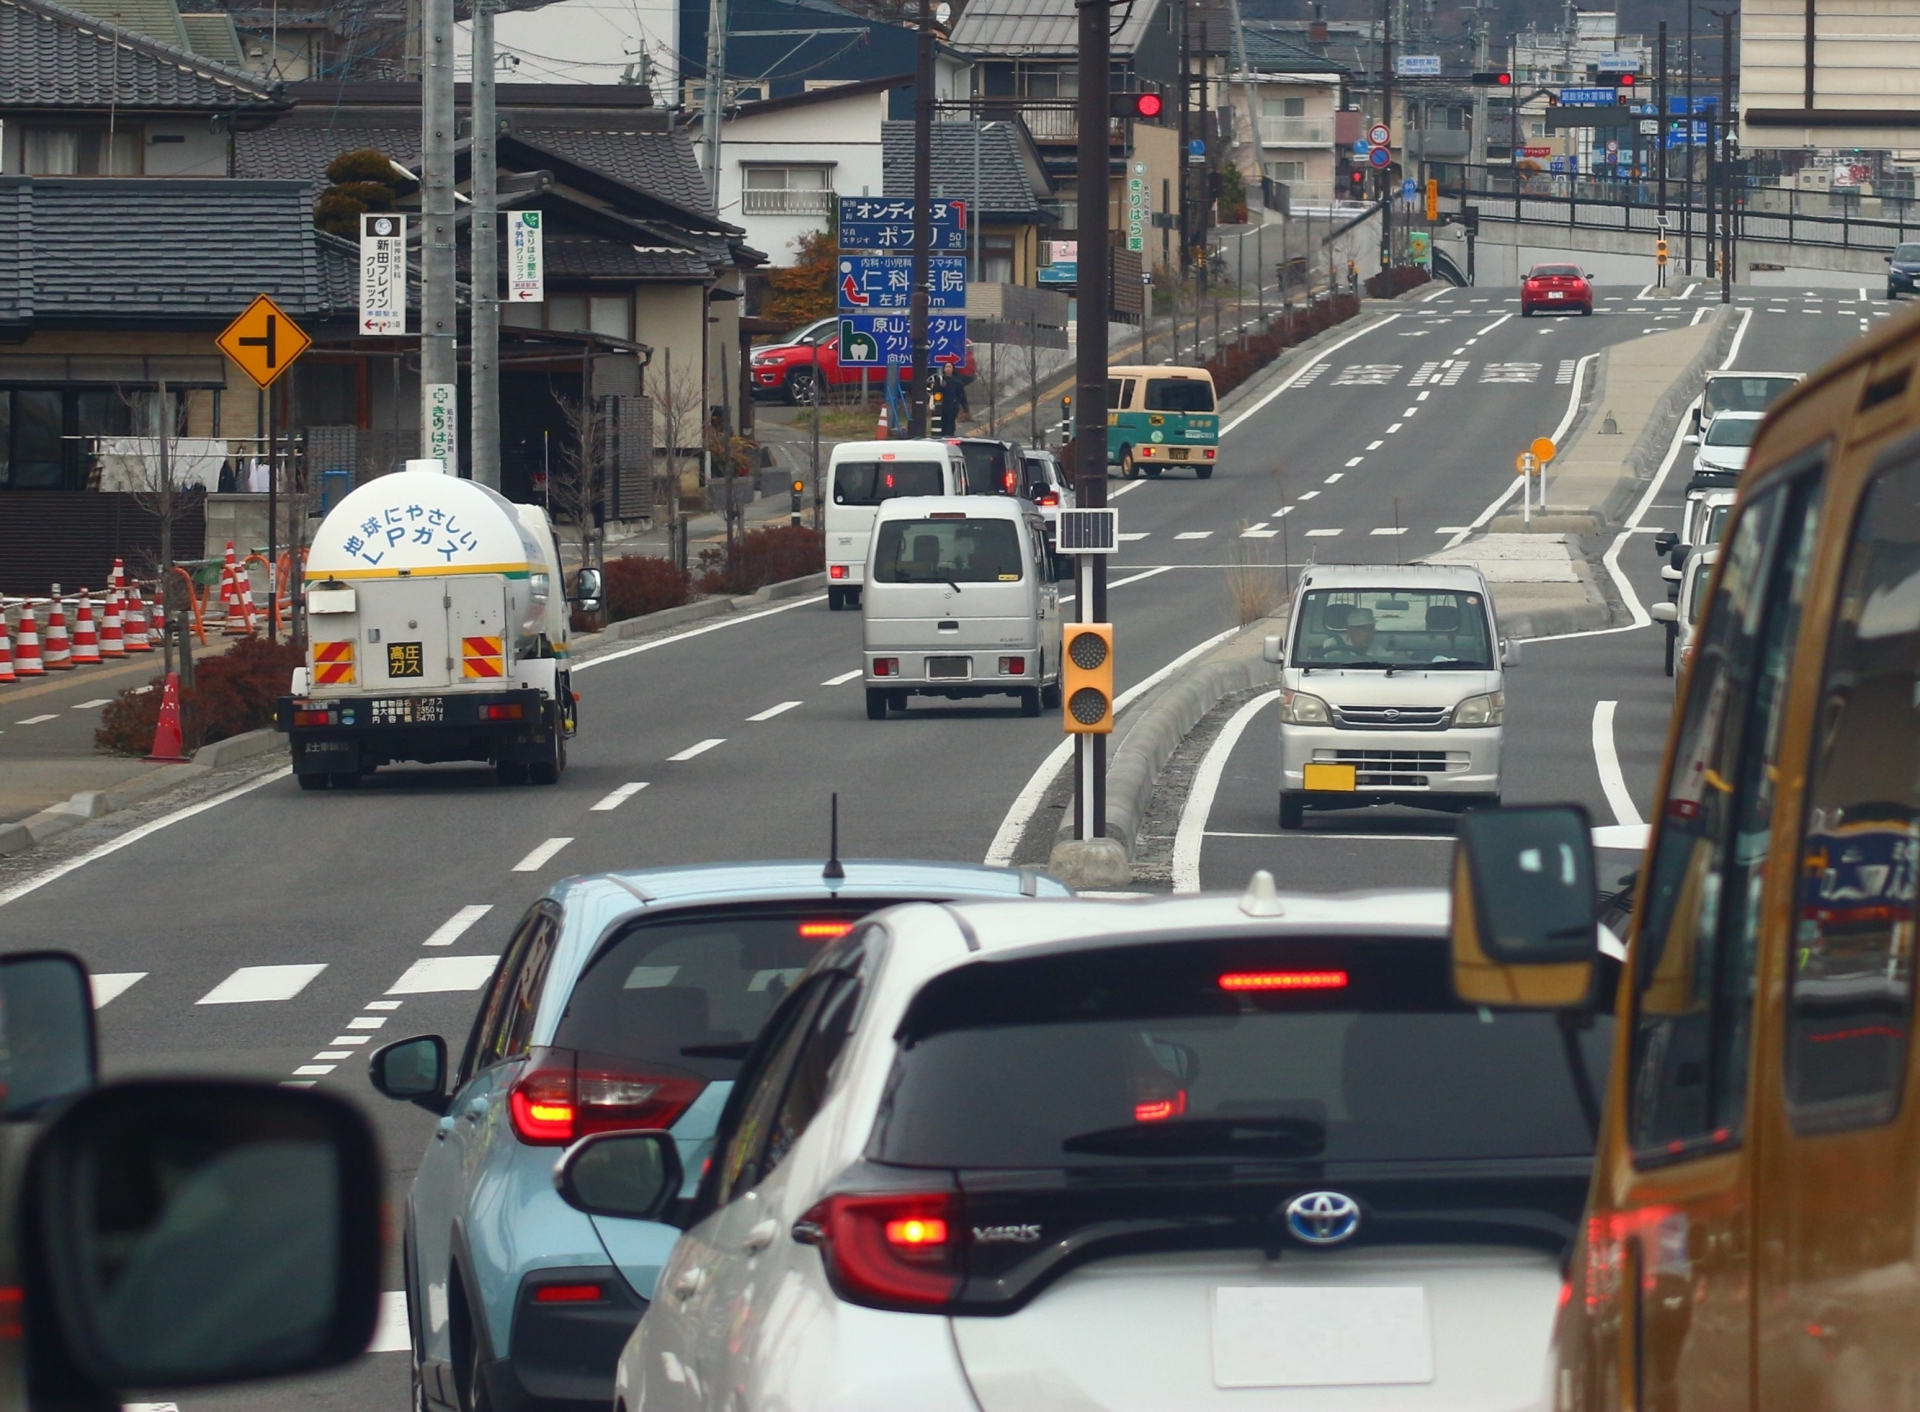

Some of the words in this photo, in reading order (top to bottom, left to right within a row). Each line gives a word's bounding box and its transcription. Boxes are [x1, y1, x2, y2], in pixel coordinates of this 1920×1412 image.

[1373, 130, 1386, 140] 50
[856, 201, 948, 220] オンディヌ
[514, 221, 524, 280] 手外科クリニック
[949, 232, 962, 241] 50
[527, 229, 537, 279] きりはら整形
[366, 256, 376, 309] クリニック
[376, 239, 390, 309] 新田ブレイン
[342, 504, 478, 558] 地球にやさしい
[390, 645, 420, 660] 高圧
[391, 660, 421, 675] ガス
